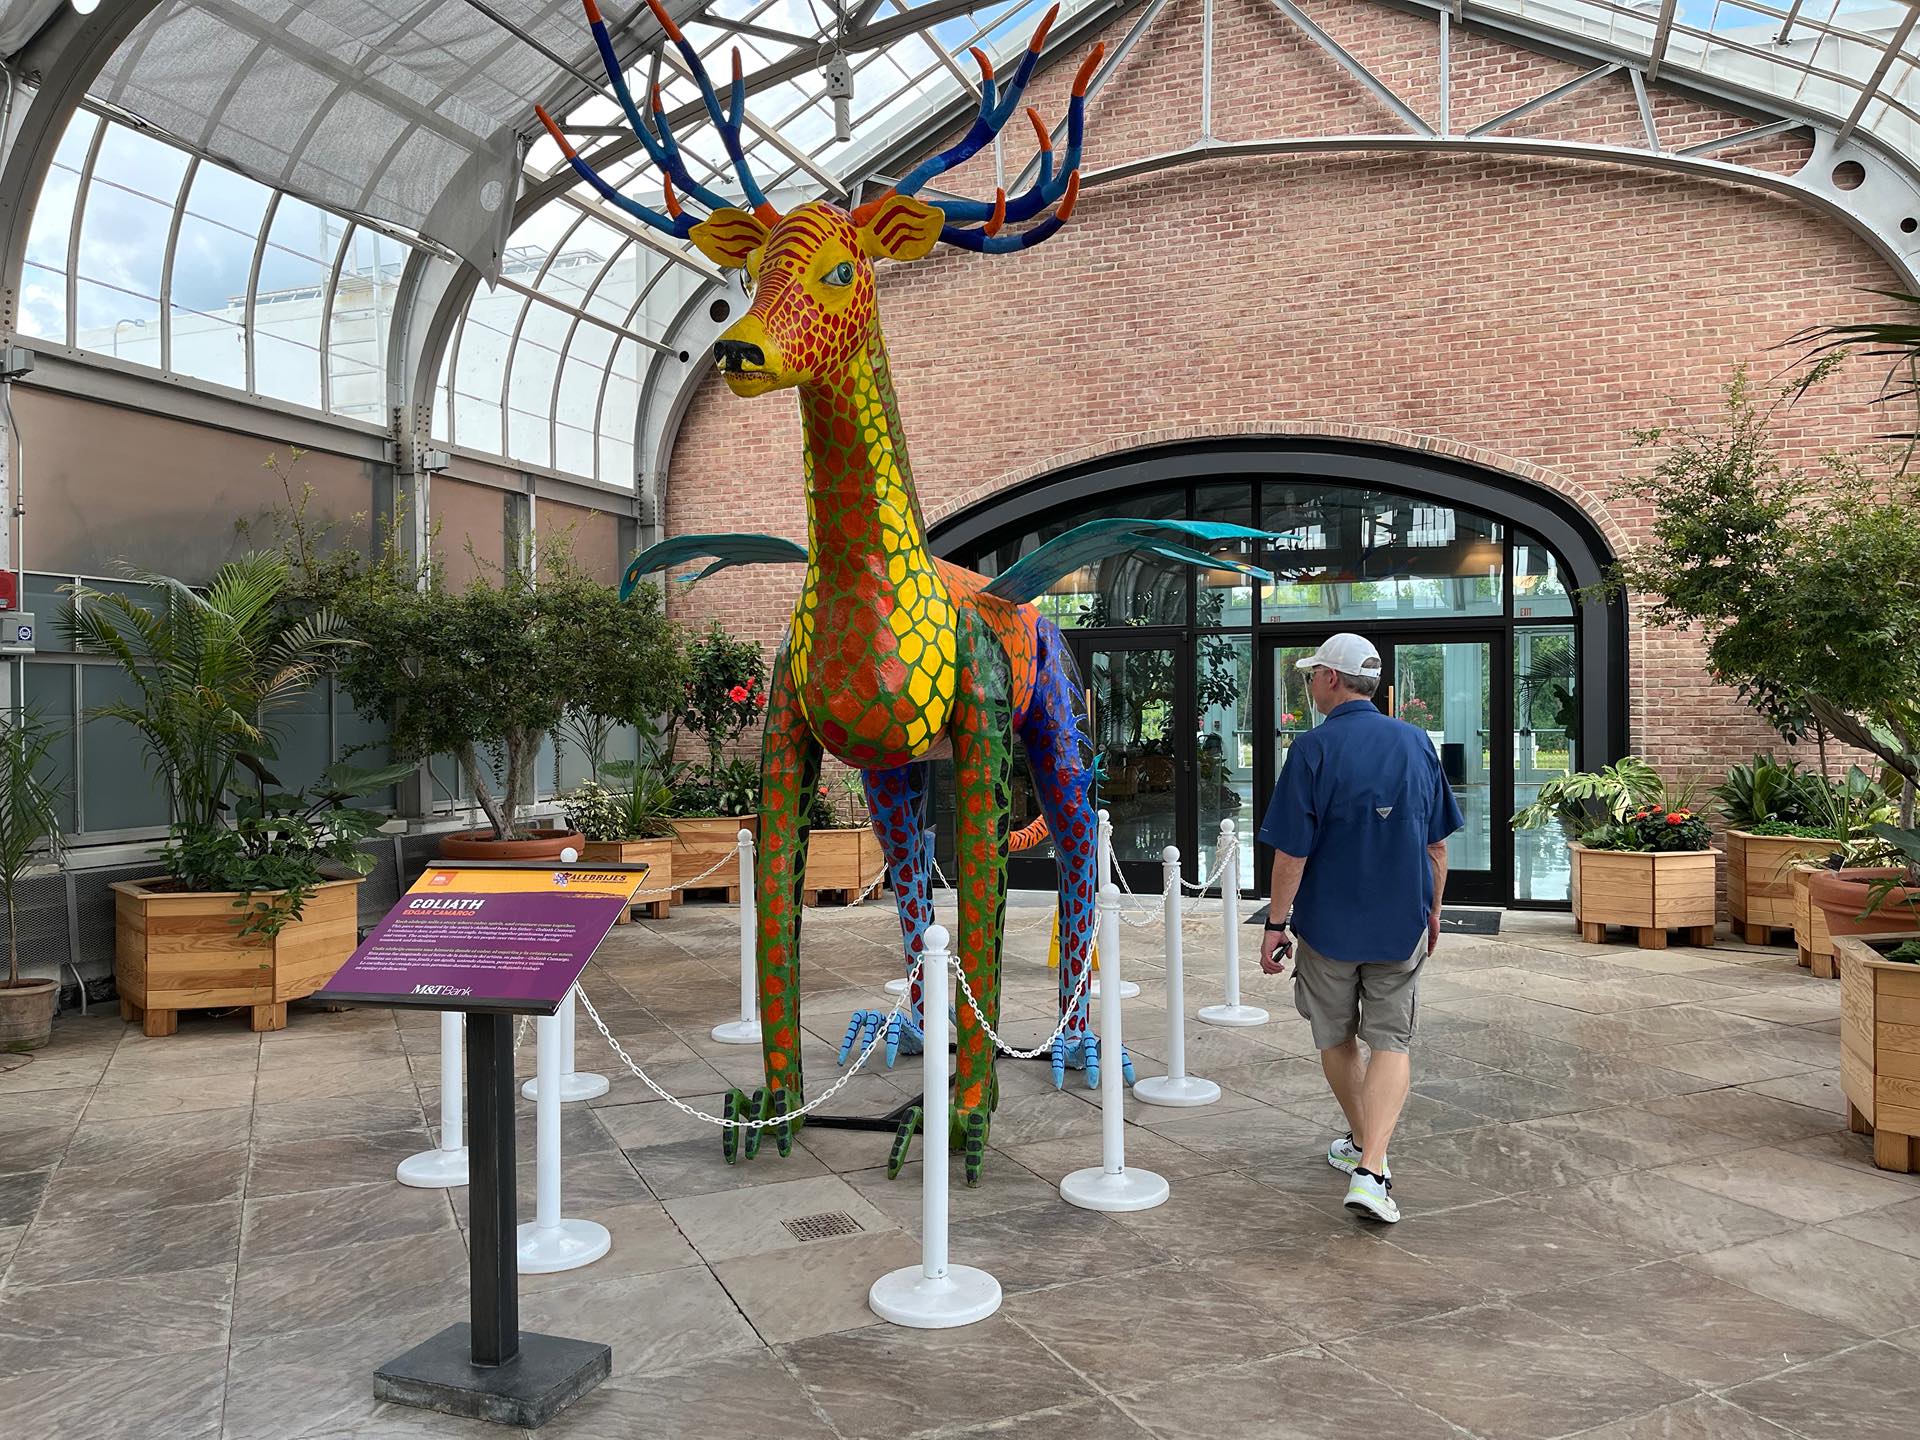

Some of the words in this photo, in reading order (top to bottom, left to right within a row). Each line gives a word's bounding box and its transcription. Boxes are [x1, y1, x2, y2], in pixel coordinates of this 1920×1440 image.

[569, 873, 627, 881] ALEBRIJES
[409, 899, 486, 909] GOLIATH
[410, 984, 446, 995] M&T
[441, 985, 473, 996] Bank
